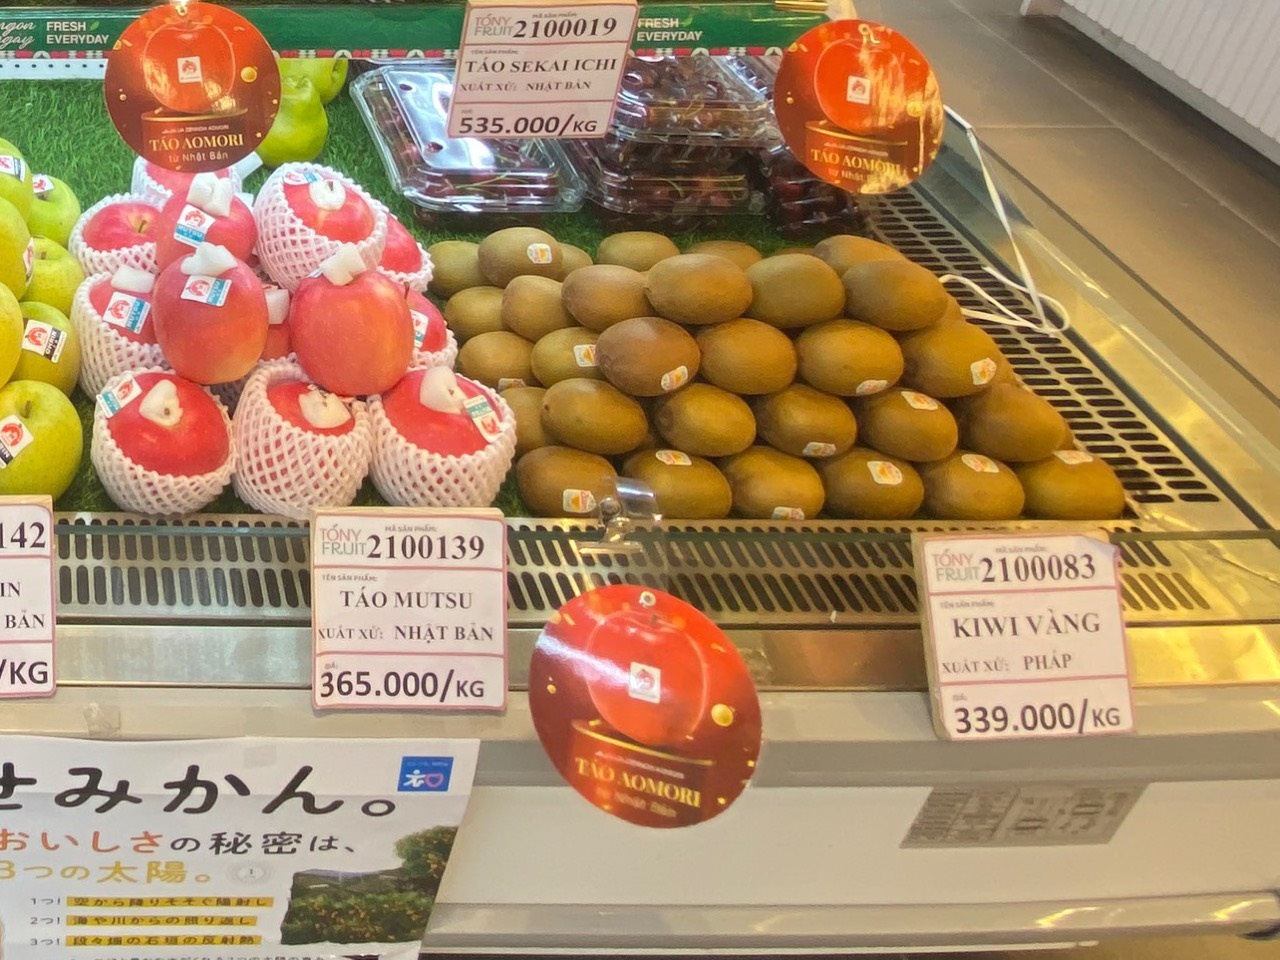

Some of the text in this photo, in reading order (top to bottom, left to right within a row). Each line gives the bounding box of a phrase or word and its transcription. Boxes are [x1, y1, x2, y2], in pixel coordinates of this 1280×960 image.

[47, 22, 86, 32] FRESH
[474, 25, 514, 36] FRUIT
[513, 17, 617, 38] 2100019
[637, 17, 679, 28] FRESH
[47, 34, 109, 44] EVERYDAY
[636, 31, 703, 41] EVERYDAY
[465, 57, 617, 73] TÁO SEKAI ICHI
[459, 114, 597, 136] 535.000/KG
[182, 134, 244, 150] AOMORI
[182, 151, 228, 162] Nhật Bản
[45, 329, 60, 354] OHRIN
[322, 542, 367, 556] FRUIT
[367, 534, 484, 560] 2100139
[936, 566, 980, 581] FRUIT
[980, 553, 1096, 583] 2100083
[340, 587, 473, 609] TÁO MUTSU
[394, 623, 449, 644] NHẬT
[953, 608, 1100, 639] KIWI VÀNG
[1023, 650, 1072, 671] PHÁP
[320, 669, 484, 703] 365.000/KG
[954, 698, 1121, 734] 339.000/KG
[619, 775, 702, 808] AOMORI
